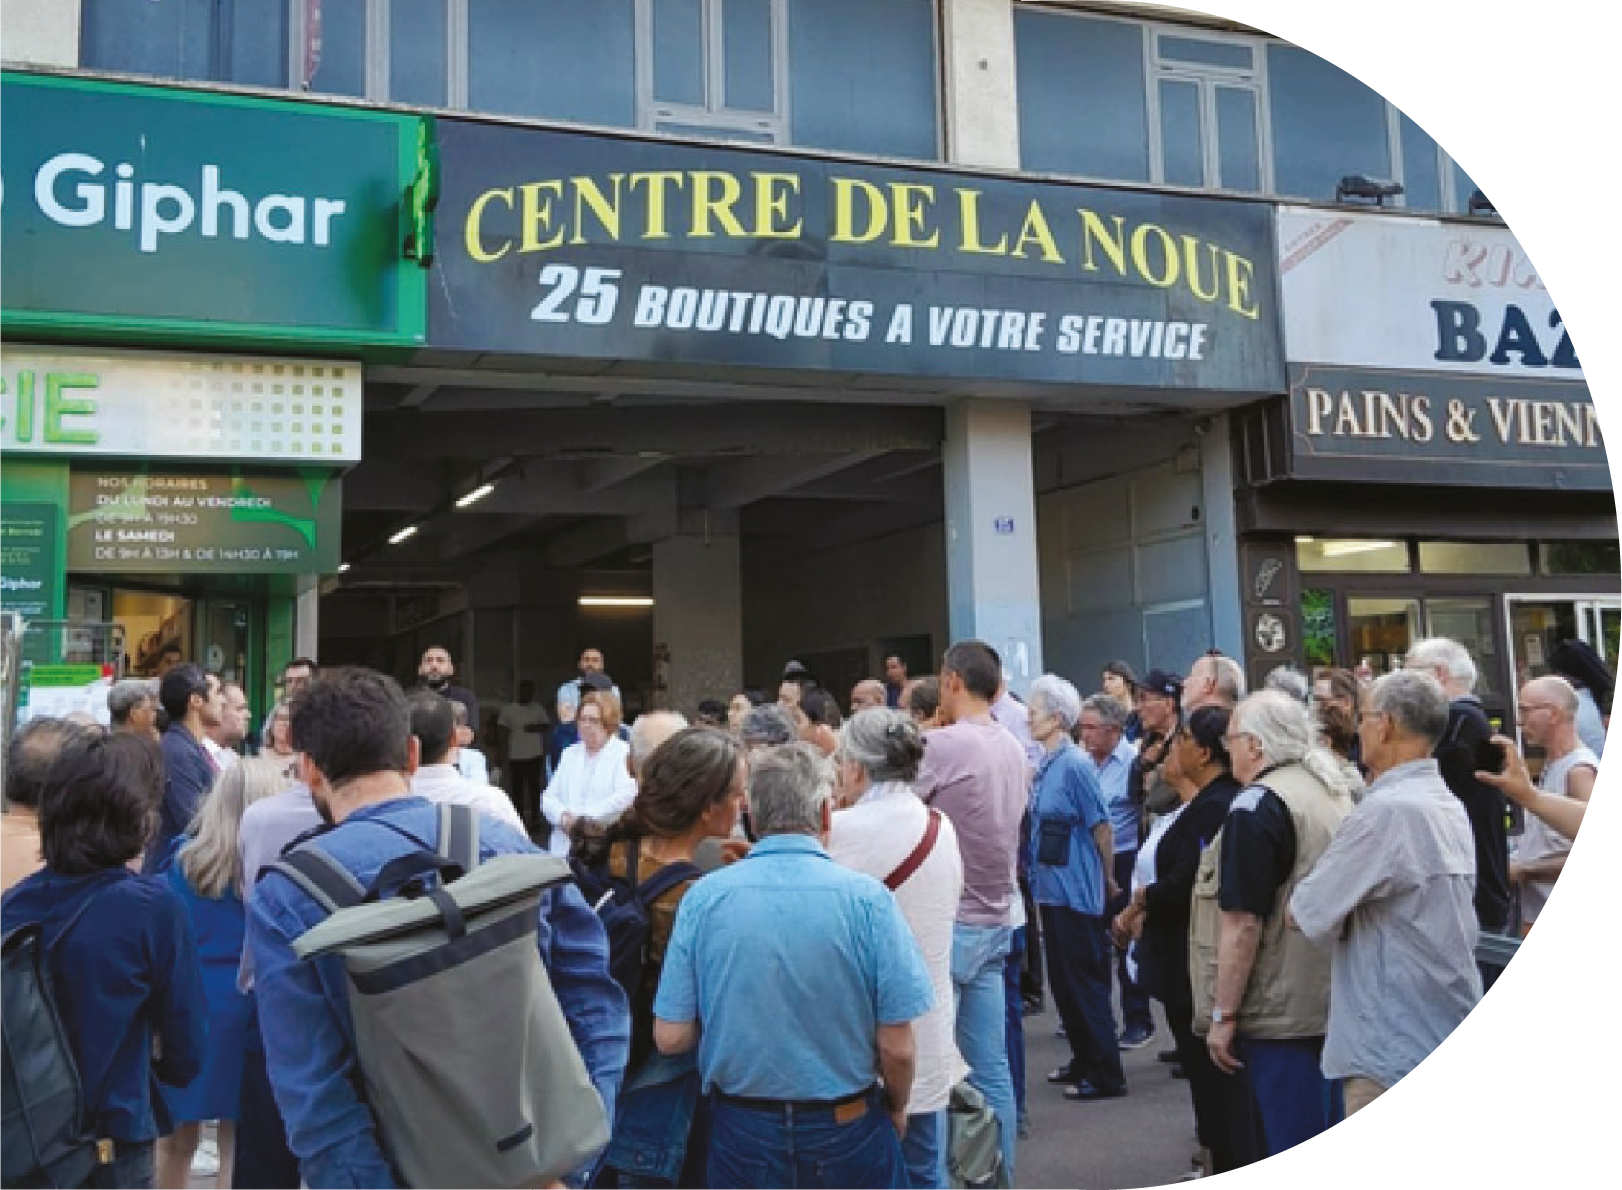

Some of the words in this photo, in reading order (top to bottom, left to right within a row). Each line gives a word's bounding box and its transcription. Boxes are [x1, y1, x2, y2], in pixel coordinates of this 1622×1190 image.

[35, 153, 346, 252] Giphar
[464, 170, 803, 263] CENTRE
[828, 177, 939, 249] DE
[954, 187, 1066, 264] LA
[1076, 208, 1260, 320] NOUE
[530, 263, 623, 325] 25
[633, 285, 875, 341] BOUTIQUES
[885, 303, 914, 345] A
[929, 306, 1047, 352] VOTRE
[1055, 315, 1208, 361] SERVICE
[0, 371, 100, 444] IE
[1306, 387, 1433, 443] PAINS
[1446, 397, 1481, 443] &
[95, 529, 113, 542] LE
[117, 529, 175, 542] SAMEDI
[173, 495, 195, 507] AU
[197, 496, 271, 508] VENDREDI
